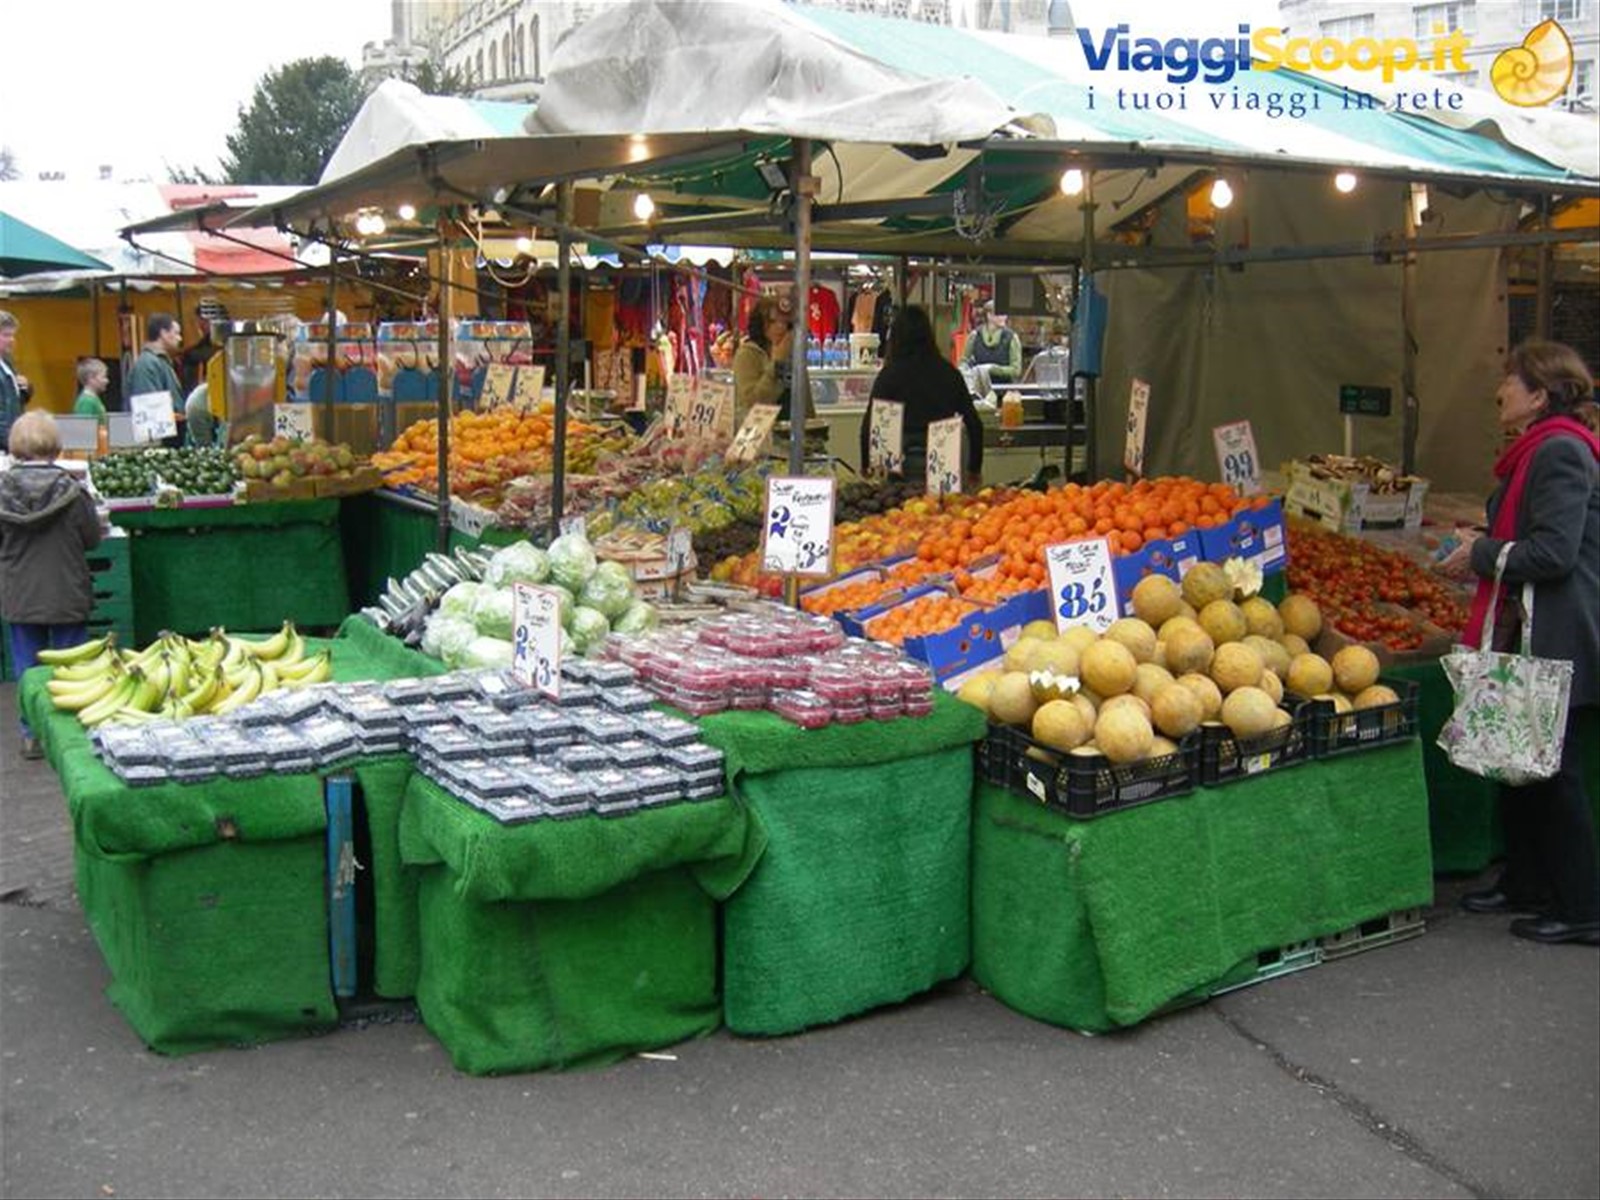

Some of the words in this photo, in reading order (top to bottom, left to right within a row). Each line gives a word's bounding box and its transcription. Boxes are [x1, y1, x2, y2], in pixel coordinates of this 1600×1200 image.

[1224, 450, 1254, 481] 99
[769, 505, 790, 538] 2
[1059, 576, 1106, 619] 85
[516, 624, 528, 660] 2
